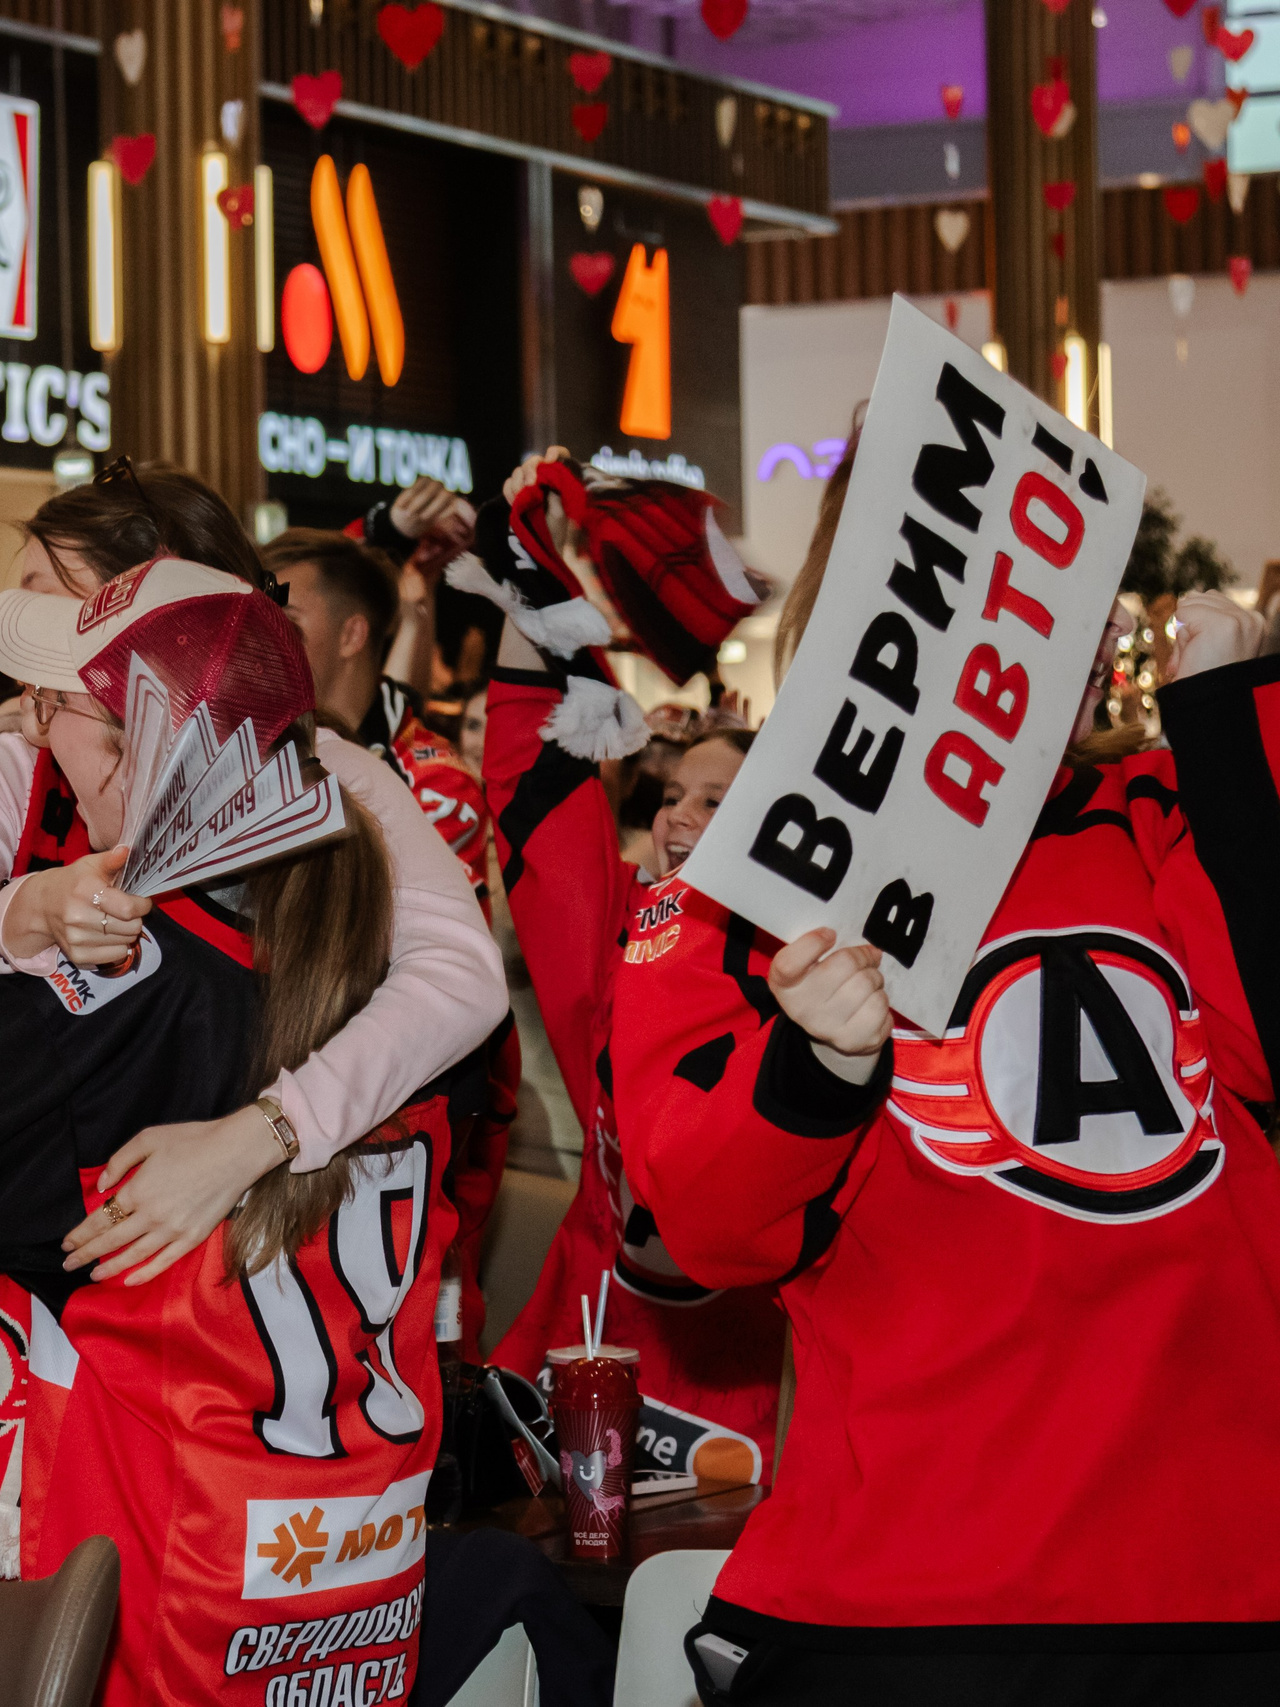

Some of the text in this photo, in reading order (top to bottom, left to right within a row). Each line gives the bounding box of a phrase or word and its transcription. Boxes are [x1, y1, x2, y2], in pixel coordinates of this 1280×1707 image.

[748, 361, 1006, 902] ВЕРИМ
[863, 422, 1109, 969] В АВТО!
[635, 888, 688, 932] МК
[49, 970, 83, 1013] MMC
[57, 960, 96, 1006] ГМК
[1033, 942, 1185, 1147] А
[636, 1426, 678, 1466] ne
[335, 1505, 427, 1563] МОТ
[573, 1531, 588, 1539] ВСЁ
[266, 1652, 408, 1707] ОБЛАСТЬ
